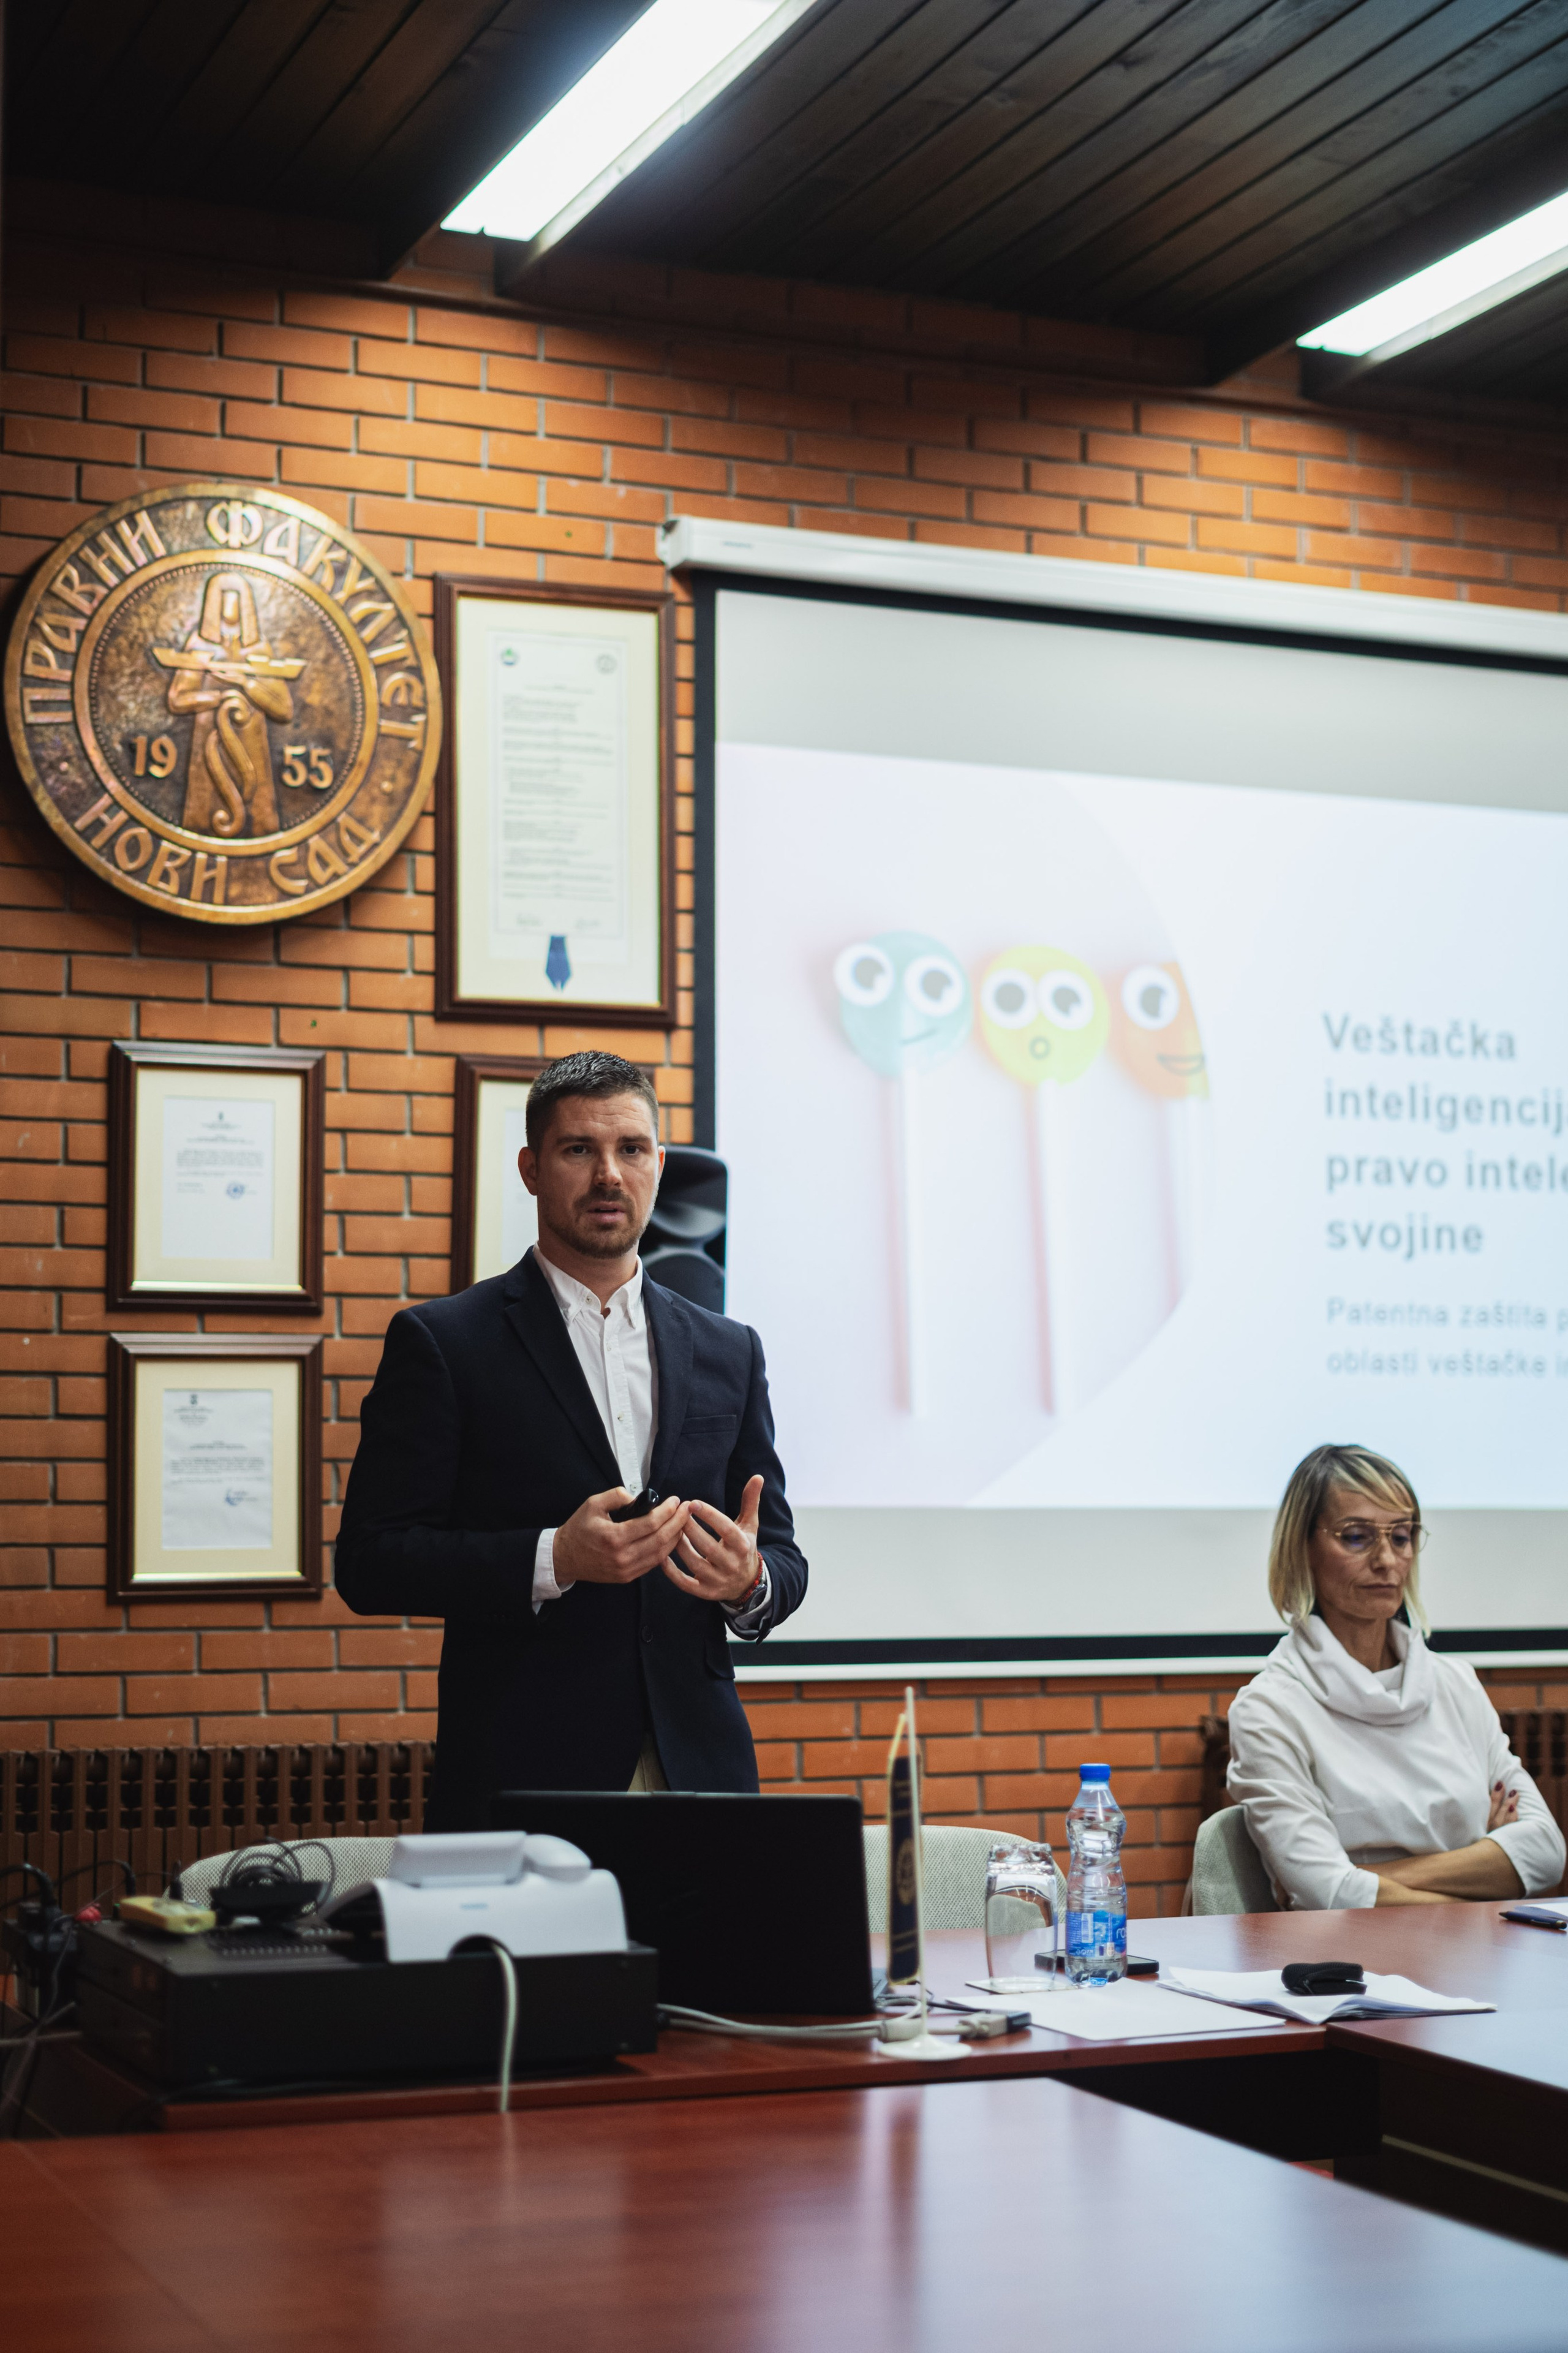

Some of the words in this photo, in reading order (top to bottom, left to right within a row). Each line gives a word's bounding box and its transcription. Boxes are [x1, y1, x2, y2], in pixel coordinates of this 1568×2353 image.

[270, 811, 381, 894] САД
[1321, 1011, 1518, 1061] Veštačka
[1324, 1077, 1568, 1137] inteligencij
[1325, 1152, 1449, 1193] pravo
[1324, 1212, 1486, 1262] svojine
[1326, 1295, 1449, 1328] Patentna
[1460, 1298, 1548, 1330] zaštita
[1326, 1345, 1420, 1378] oblasti
